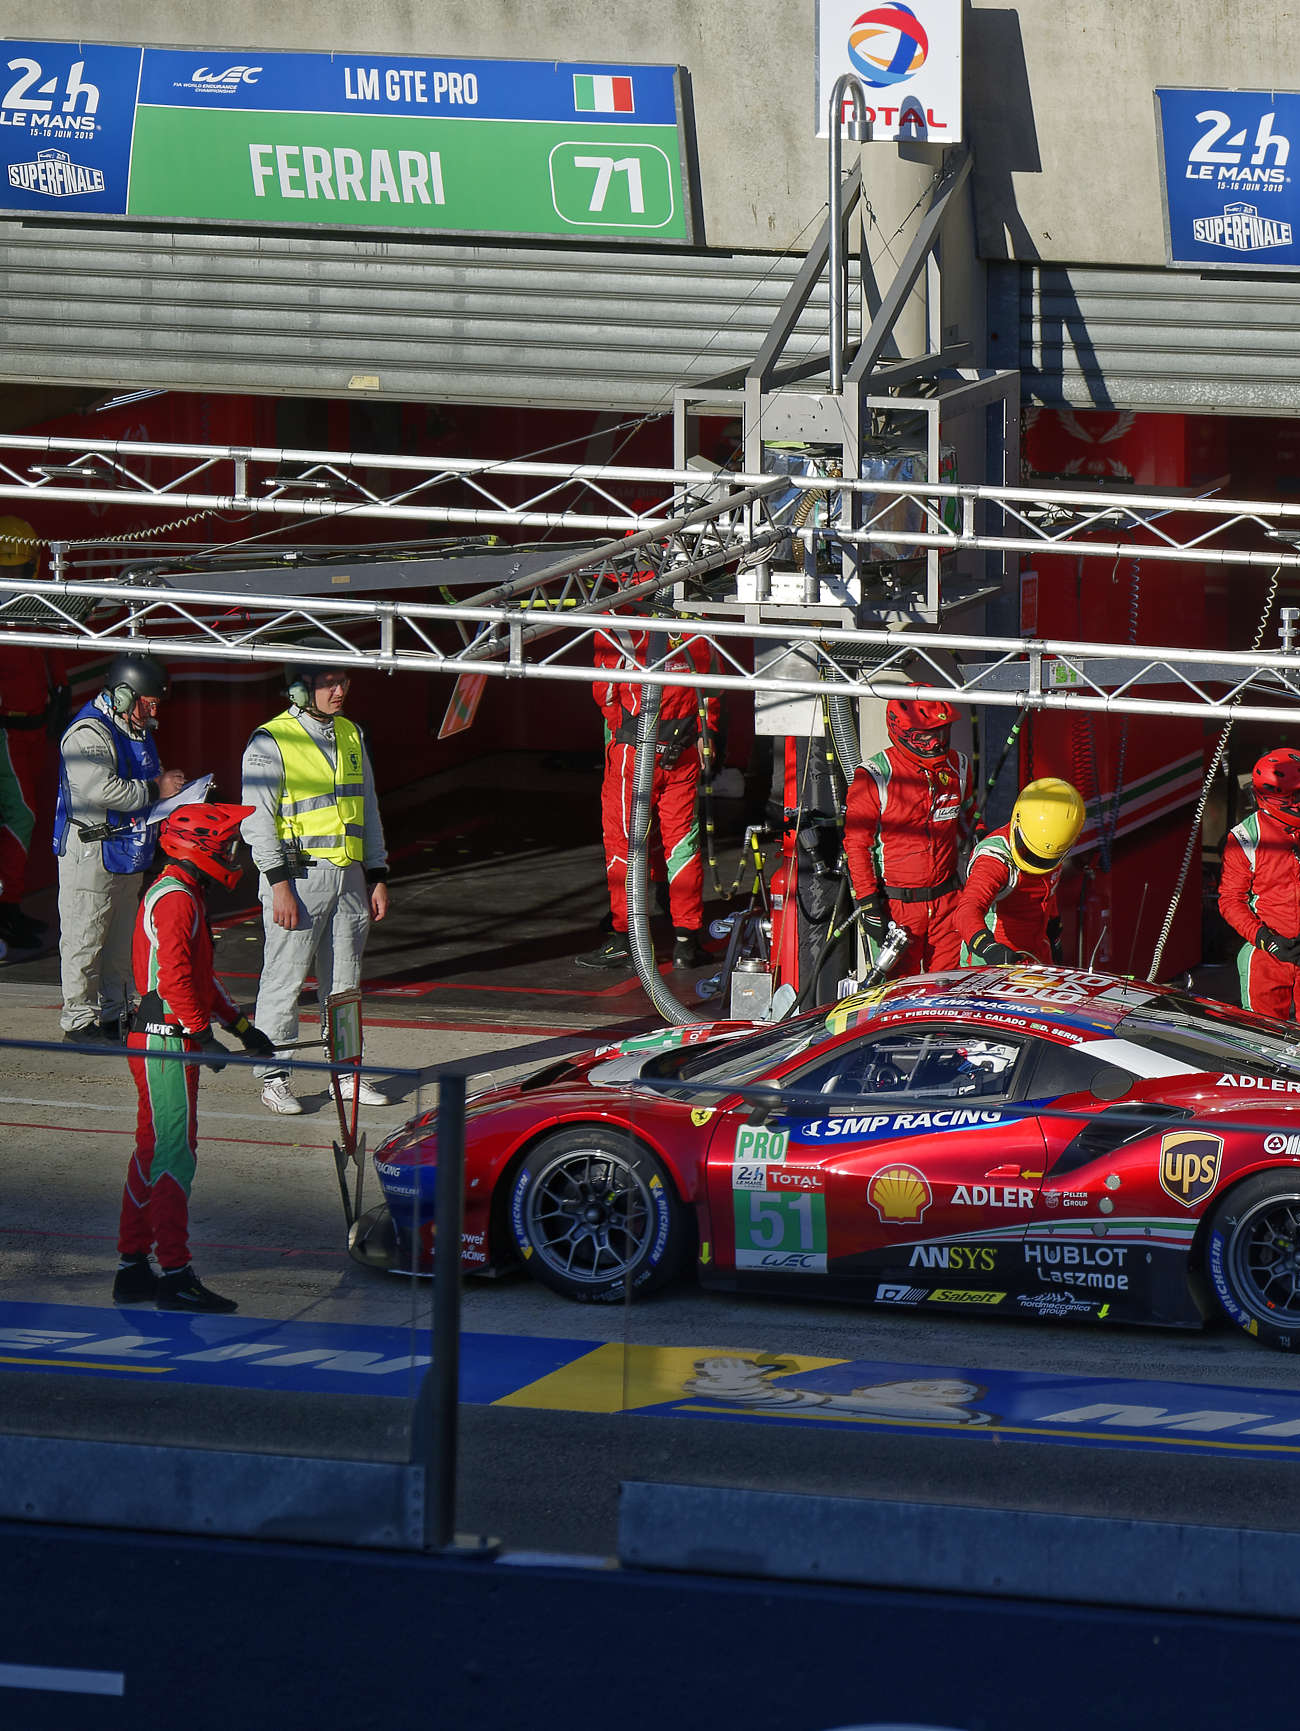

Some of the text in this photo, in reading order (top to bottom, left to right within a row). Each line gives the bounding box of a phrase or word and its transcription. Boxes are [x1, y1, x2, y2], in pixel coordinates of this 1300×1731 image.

[2, 58, 100, 113] 24h
[192, 66, 263, 84] WEC
[344, 67, 479, 105] LM GTE PRO
[0, 112, 95, 130] LE MANS
[841, 100, 947, 128] TOTAL
[30, 129, 94, 140] 15-16 JUIN 2019
[1188, 110, 1290, 166] 24h
[10, 161, 103, 195] SUPERFINALE
[249, 143, 446, 205] FERRARI
[574, 156, 645, 213] 71
[1185, 164, 1285, 183] LE MANS
[1217, 181, 1283, 192] 15-16 JUIN 2019
[1195, 215, 1290, 249] SUPERFINALE
[936, 999, 1038, 1015] SMP RACING
[985, 1013, 1027, 1027] CALADO
[1040, 1024, 1049, 1033] D.
[1051, 1028, 1085, 1044] SERRA
[824, 1110, 1002, 1137] SMP RACING
[738, 1131, 784, 1160] PRO
[769, 1171, 823, 1186] TOTAL
[1165, 1152, 1218, 1194] ups
[950, 1185, 1034, 1208] ADLER
[652, 1199, 670, 1263] MICHELIN
[749, 1192, 814, 1249] 51
[761, 1254, 816, 1268] WEC
[909, 1246, 996, 1271] ANSYS
[1024, 1245, 1128, 1266] HUBLOT
[1211, 1237, 1239, 1314] MICHELIN
